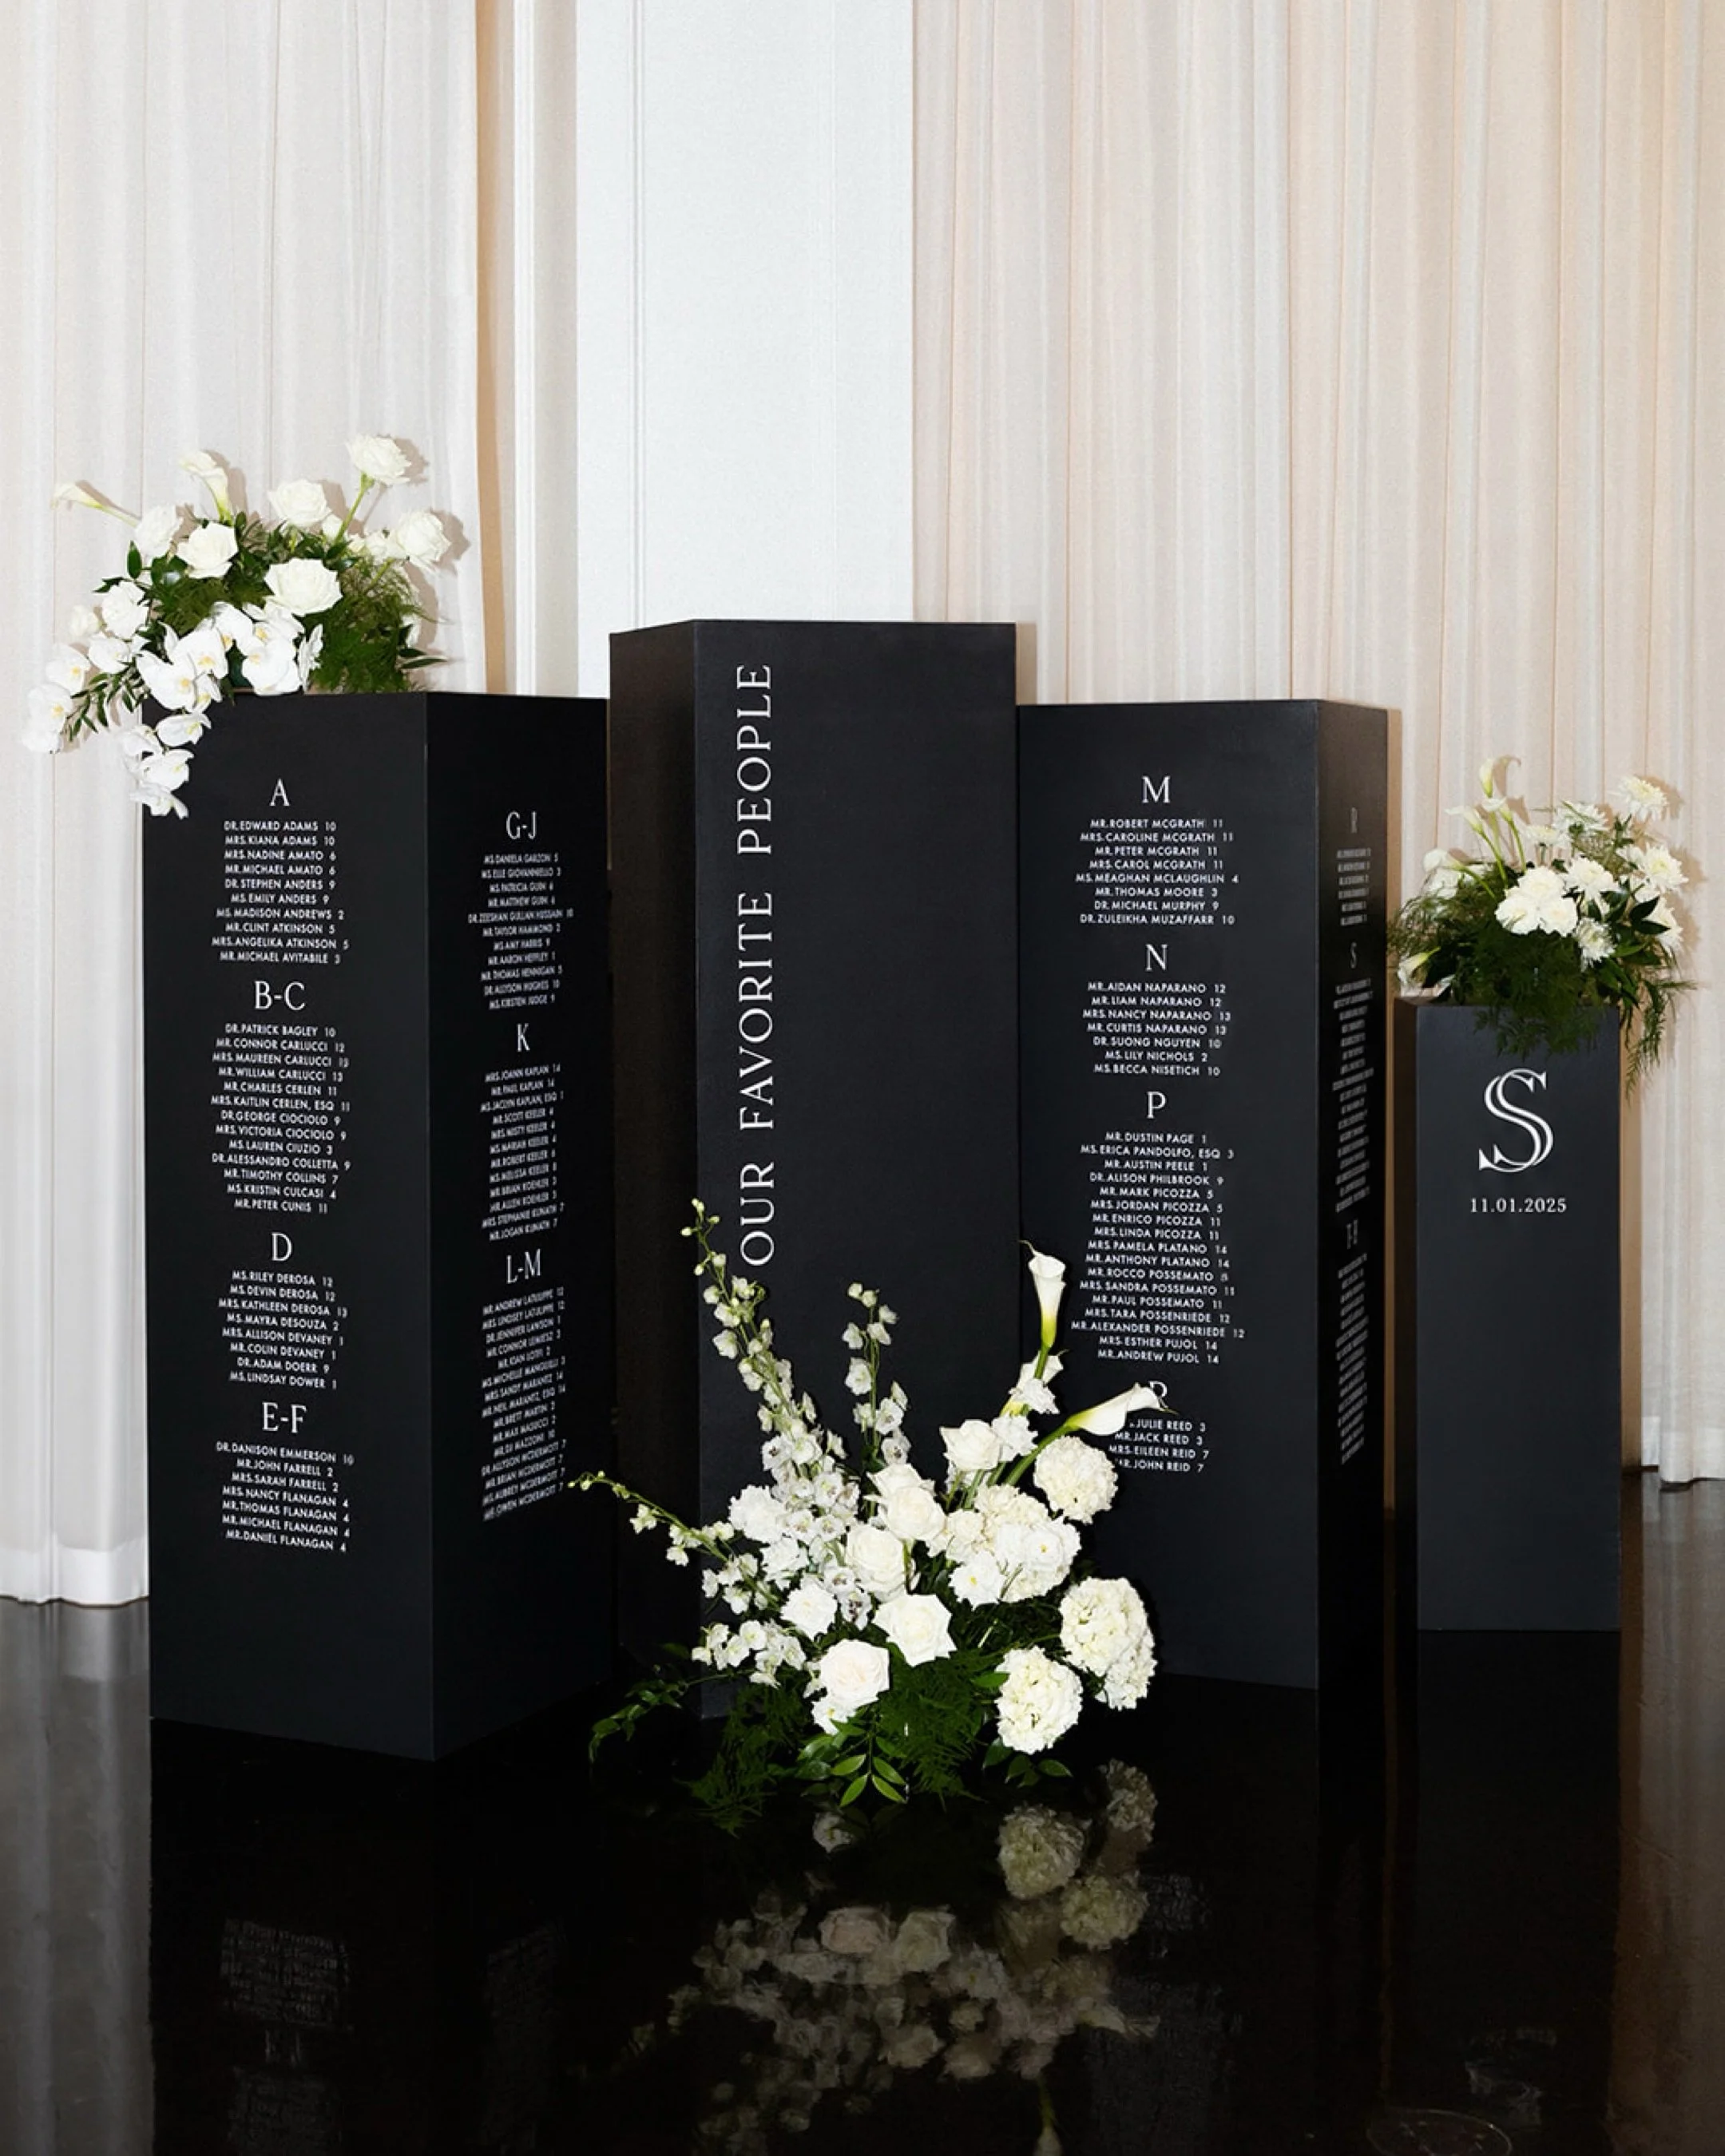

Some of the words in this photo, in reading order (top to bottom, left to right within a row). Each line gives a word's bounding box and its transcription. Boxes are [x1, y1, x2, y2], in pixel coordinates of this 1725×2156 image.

[737, 664, 772, 854] PEOPLE
[271, 779, 289, 806] A
[1143, 776, 1170, 803] M
[1151, 818, 1204, 829] MCGRATH
[1161, 832, 1215, 842] MCGRATH
[1146, 846, 1200, 856] MCGRATH
[1152, 859, 1205, 870] MCGRATH
[1153, 873, 1224, 884] MCLAUGHLIN
[1163, 887, 1204, 898] MOORE
[1161, 900, 1205, 910] MURPHY
[1147, 945, 1167, 971] N
[1144, 982, 1207, 993] NAPARANO
[256, 981, 304, 1010] B-C
[1140, 996, 1202, 1007] NAPARANO
[738, 893, 773, 1131] FAVORITE
[1149, 1009, 1212, 1021] NAPARANO
[1145, 1023, 1208, 1035] NAPARANO
[518, 1024, 529, 1052] K
[1154, 1036, 1200, 1048] NGUYEN
[1146, 1050, 1194, 1062] NICHOLS
[1148, 1092, 1166, 1119] P
[1166, 1132, 1194, 1144] PAGE
[1198, 1147, 1220, 1159] ESQ
[1149, 1174, 1210, 1186] PHILBROOK
[1163, 1201, 1210, 1213] PICOZZA
[1470, 1198, 1567, 1213] 11.01.2025
[740, 1163, 774, 1266] OUR
[1156, 1215, 1202, 1227] PICOZZA
[1154, 1228, 1201, 1240] PICOZZA
[272, 1233, 291, 1261] D
[1157, 1242, 1208, 1254] PLATANO
[507, 1249, 540, 1283] L-M
[1161, 1255, 1210, 1267] PLATANO
[1140, 1295, 1204, 1309] POSSEMATO
[1154, 1324, 1227, 1338] POSSENRIEDE
[1167, 1351, 1200, 1364] PUJOL
[263, 1402, 306, 1433] E-F
[1163, 1433, 1189, 1445] REED
[1172, 1447, 1196, 1459] REID
[1166, 1460, 1191, 1472] REID
